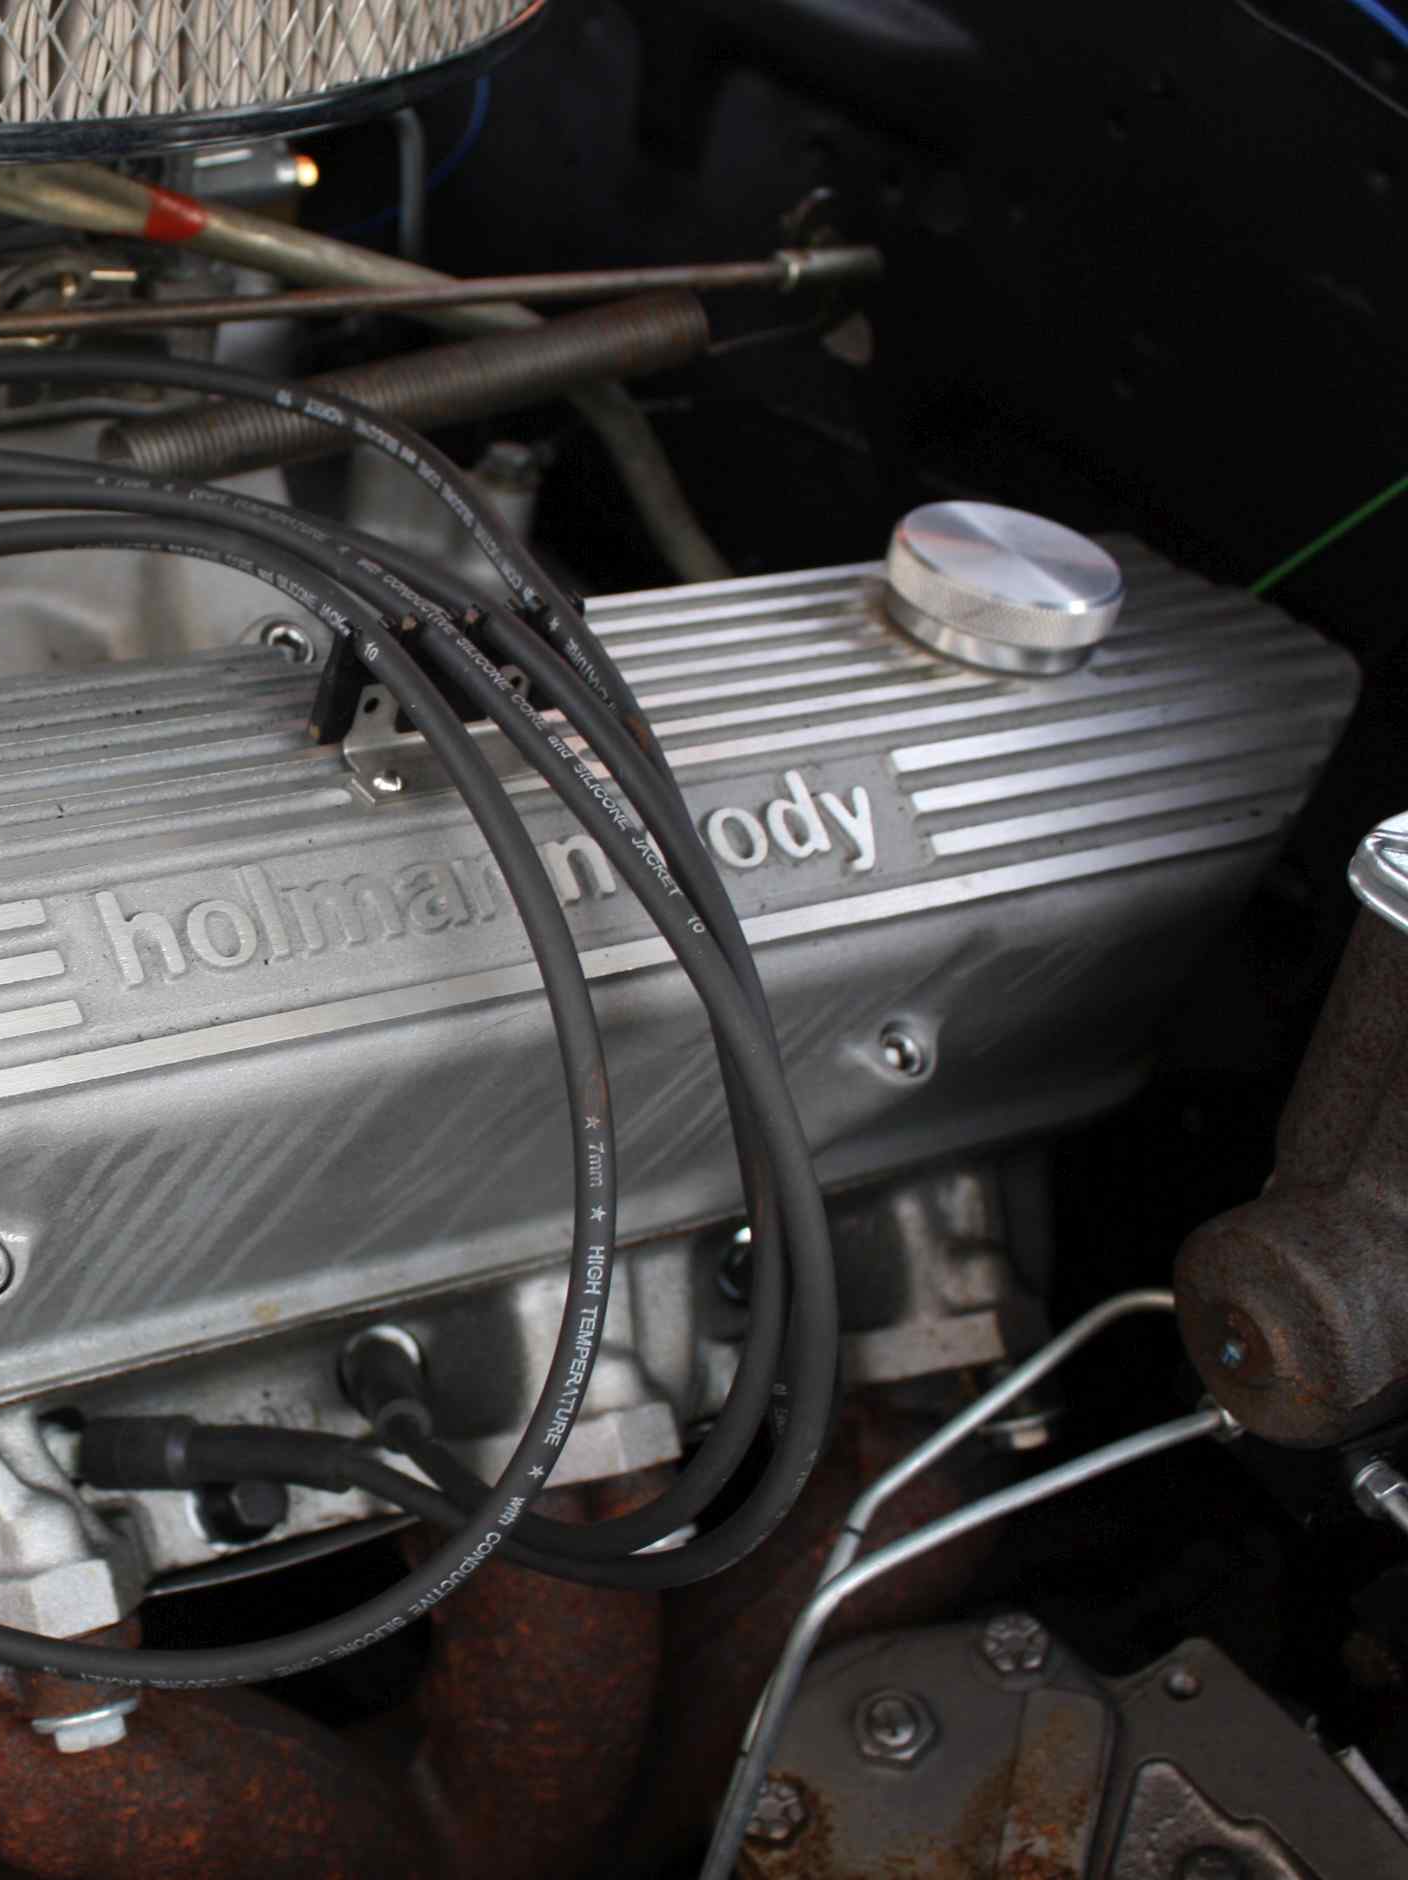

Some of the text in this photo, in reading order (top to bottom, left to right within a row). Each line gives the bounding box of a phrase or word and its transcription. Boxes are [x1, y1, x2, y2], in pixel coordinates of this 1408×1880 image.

[364, 641, 380, 662] 10
[456, 637, 509, 691] SILICONE
[511, 693, 545, 731] CORE
[547, 735, 574, 760] and
[573, 762, 629, 831] SILICONE
[632, 835, 683, 897] JACKET
[587, 1142, 605, 1188] 7mm
[583, 1246, 606, 1296] HIGH
[544, 1305, 598, 1447] TEMPERATURE
[498, 1496, 527, 1526] with
[408, 1532, 502, 1616] CONDUCTIVE
